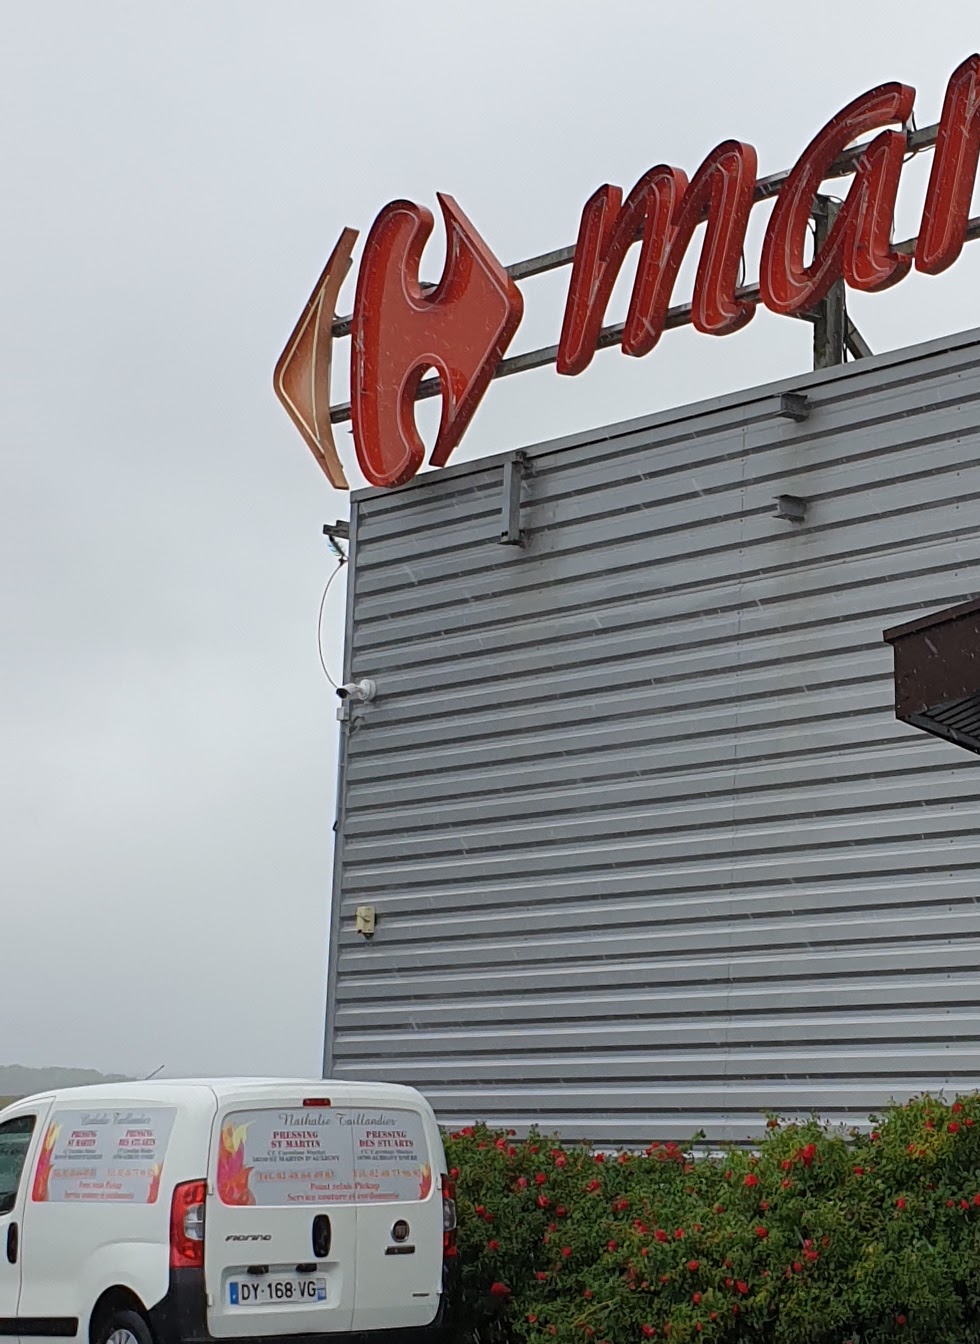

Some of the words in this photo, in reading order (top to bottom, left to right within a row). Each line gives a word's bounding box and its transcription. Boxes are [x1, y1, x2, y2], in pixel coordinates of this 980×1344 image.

[279, 1113, 331, 1126] Nathalie
[336, 1113, 397, 1126] Taillandier
[273, 1131, 319, 1139] PRESSING
[366, 1130, 406, 1139] PRESSING
[286, 1140, 320, 1148] MARTIN
[377, 1139, 414, 1147] STUARTS
